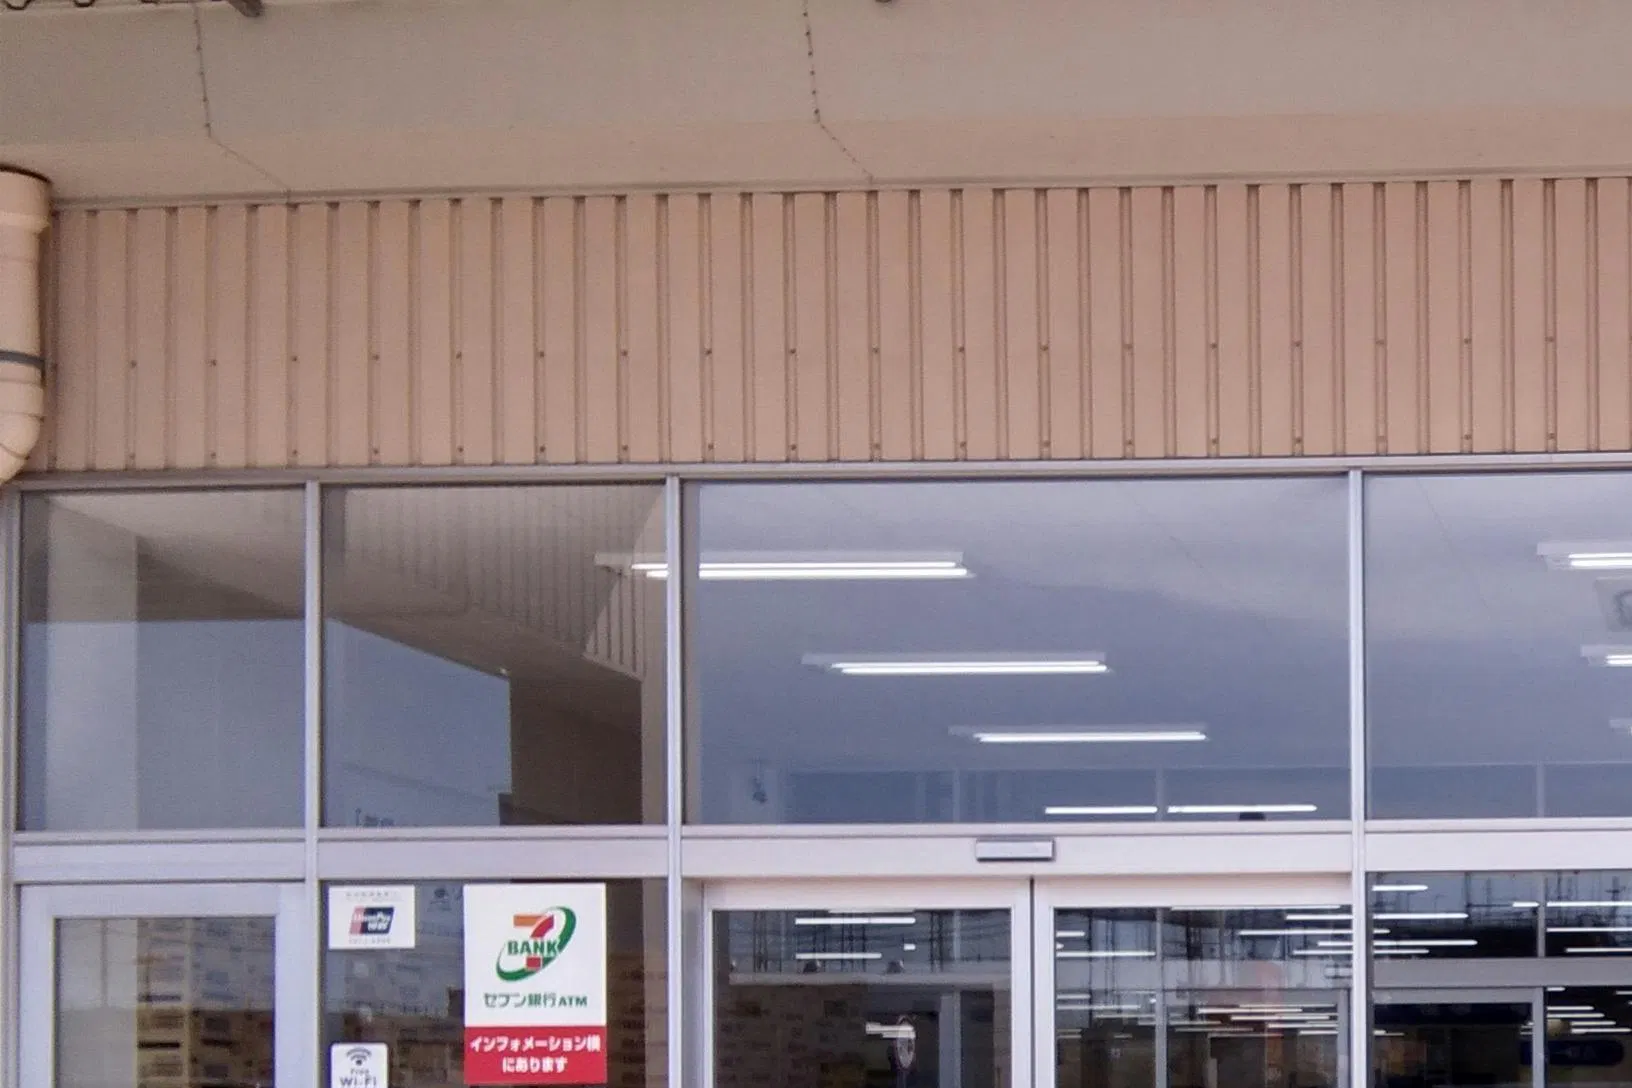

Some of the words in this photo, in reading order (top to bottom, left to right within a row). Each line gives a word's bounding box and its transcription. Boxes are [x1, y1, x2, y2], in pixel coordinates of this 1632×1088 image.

[507, 939, 560, 956] BANK
[502, 1056, 569, 1074] にあります
